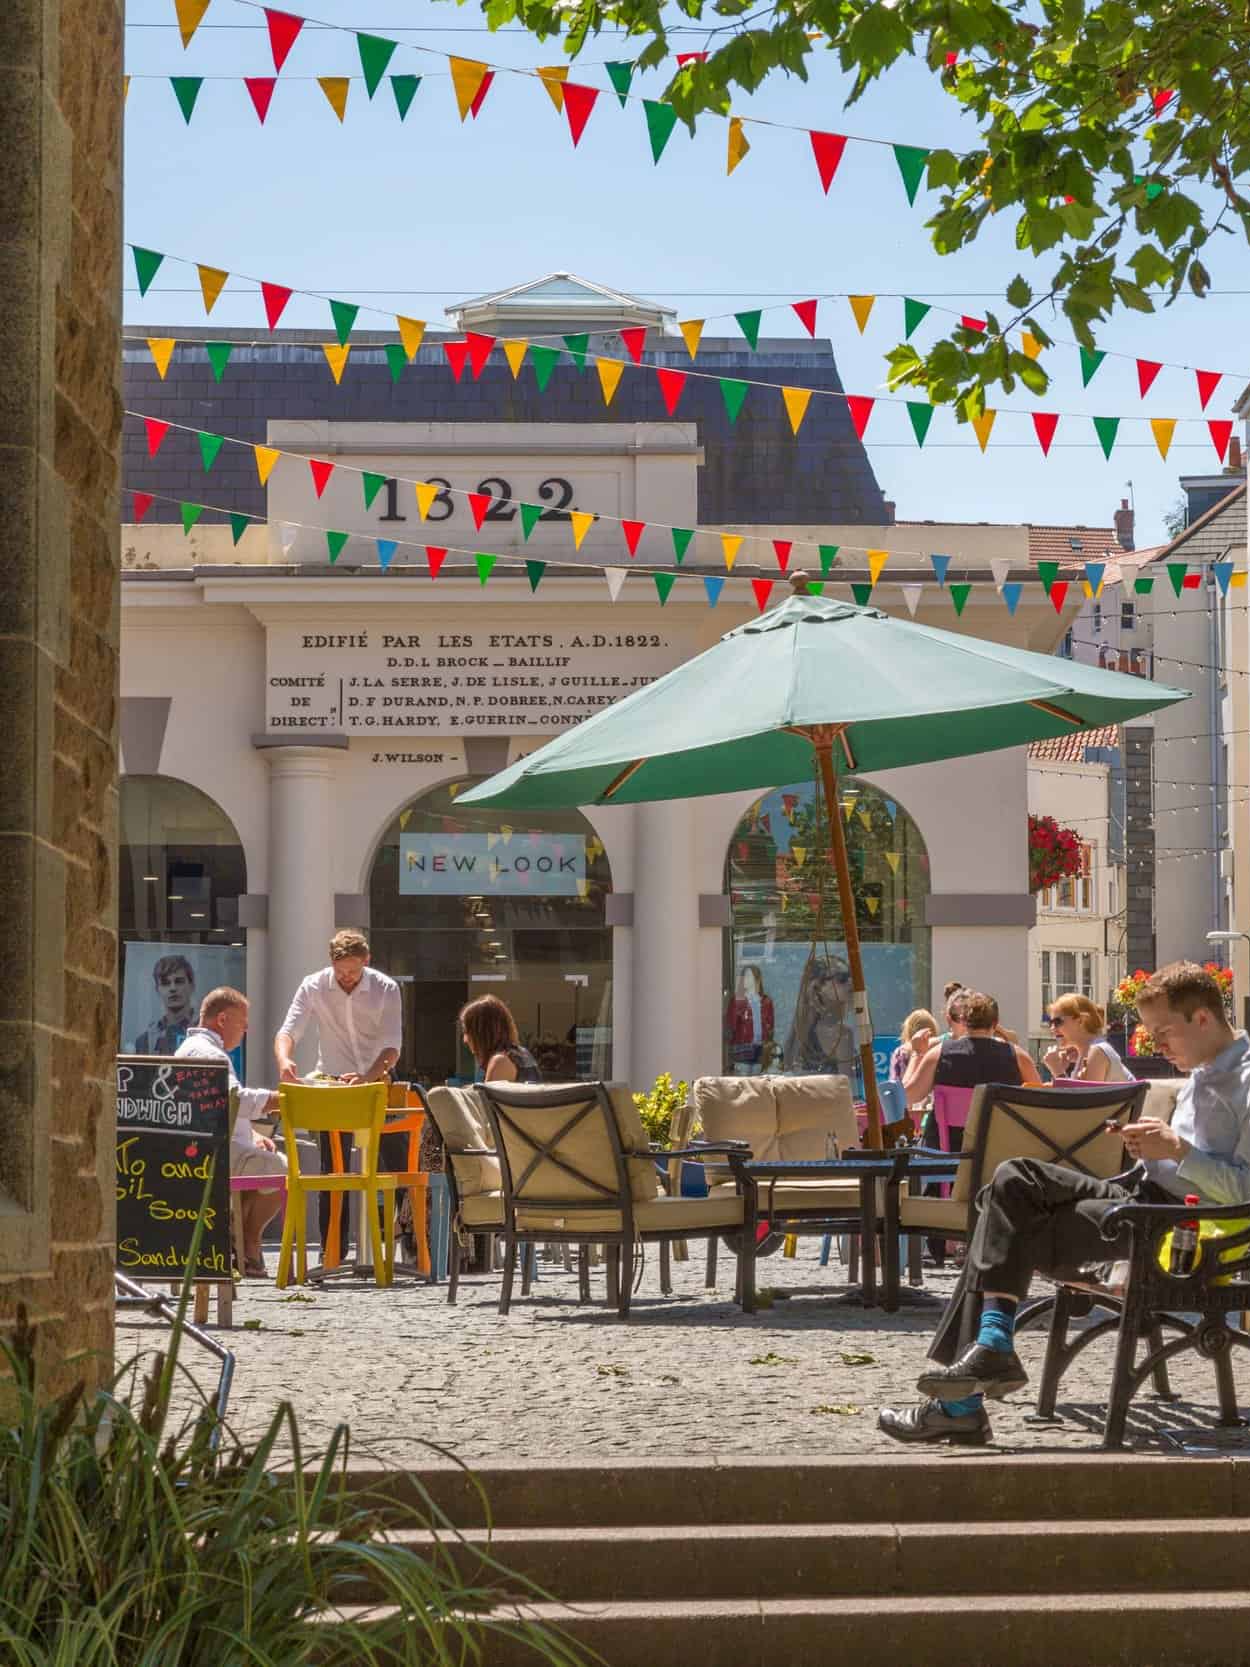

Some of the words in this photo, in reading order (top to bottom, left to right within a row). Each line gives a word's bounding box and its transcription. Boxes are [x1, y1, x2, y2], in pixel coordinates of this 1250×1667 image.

[302, 630, 368, 648] EDIFIÉ
[382, 635, 421, 648] PAR
[438, 635, 473, 648] LES
[437, 657, 489, 668] BROCK
[508, 656, 571, 667] BAILLIF
[270, 673, 325, 687] COMITÉ
[290, 697, 311, 707] DE
[408, 855, 477, 872] NEW
[496, 855, 577, 872] LOOK
[151, 1065, 179, 1100] &
[160, 1153, 212, 1180] and
[119, 1237, 229, 1273] Sandwich
